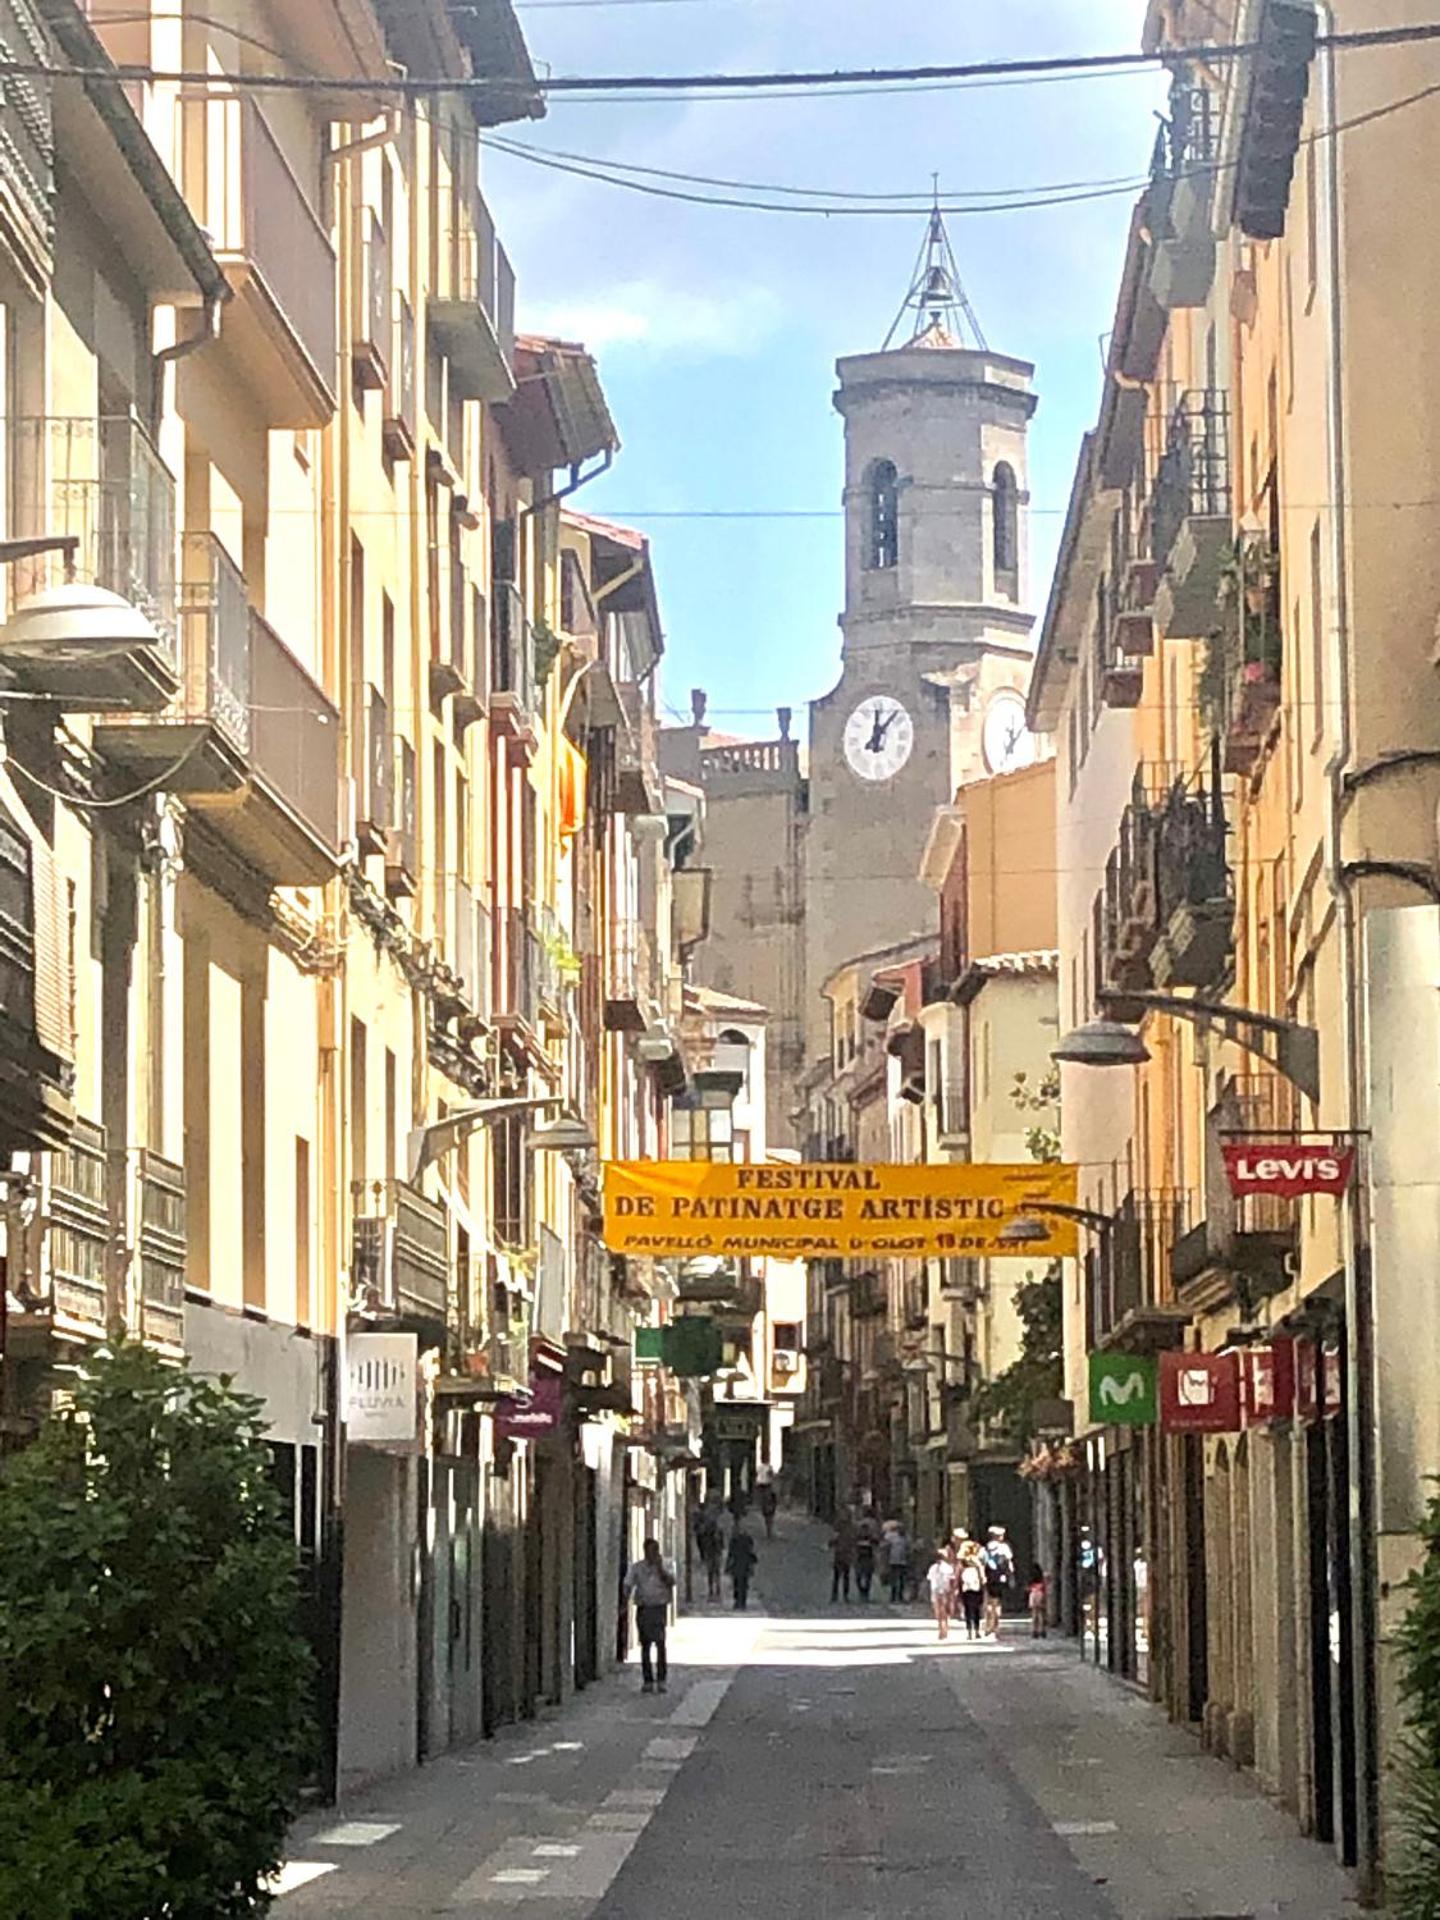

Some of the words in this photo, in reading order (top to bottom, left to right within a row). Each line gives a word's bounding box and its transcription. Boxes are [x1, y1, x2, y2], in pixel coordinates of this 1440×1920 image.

[737, 1168, 881, 1190] FESTIVAL
[614, 1195, 655, 1218] DE
[671, 1196, 844, 1219] PATINATGE
[623, 1233, 713, 1248] PAVELLÓ
[721, 1236, 840, 1249] MUNICIPAL
